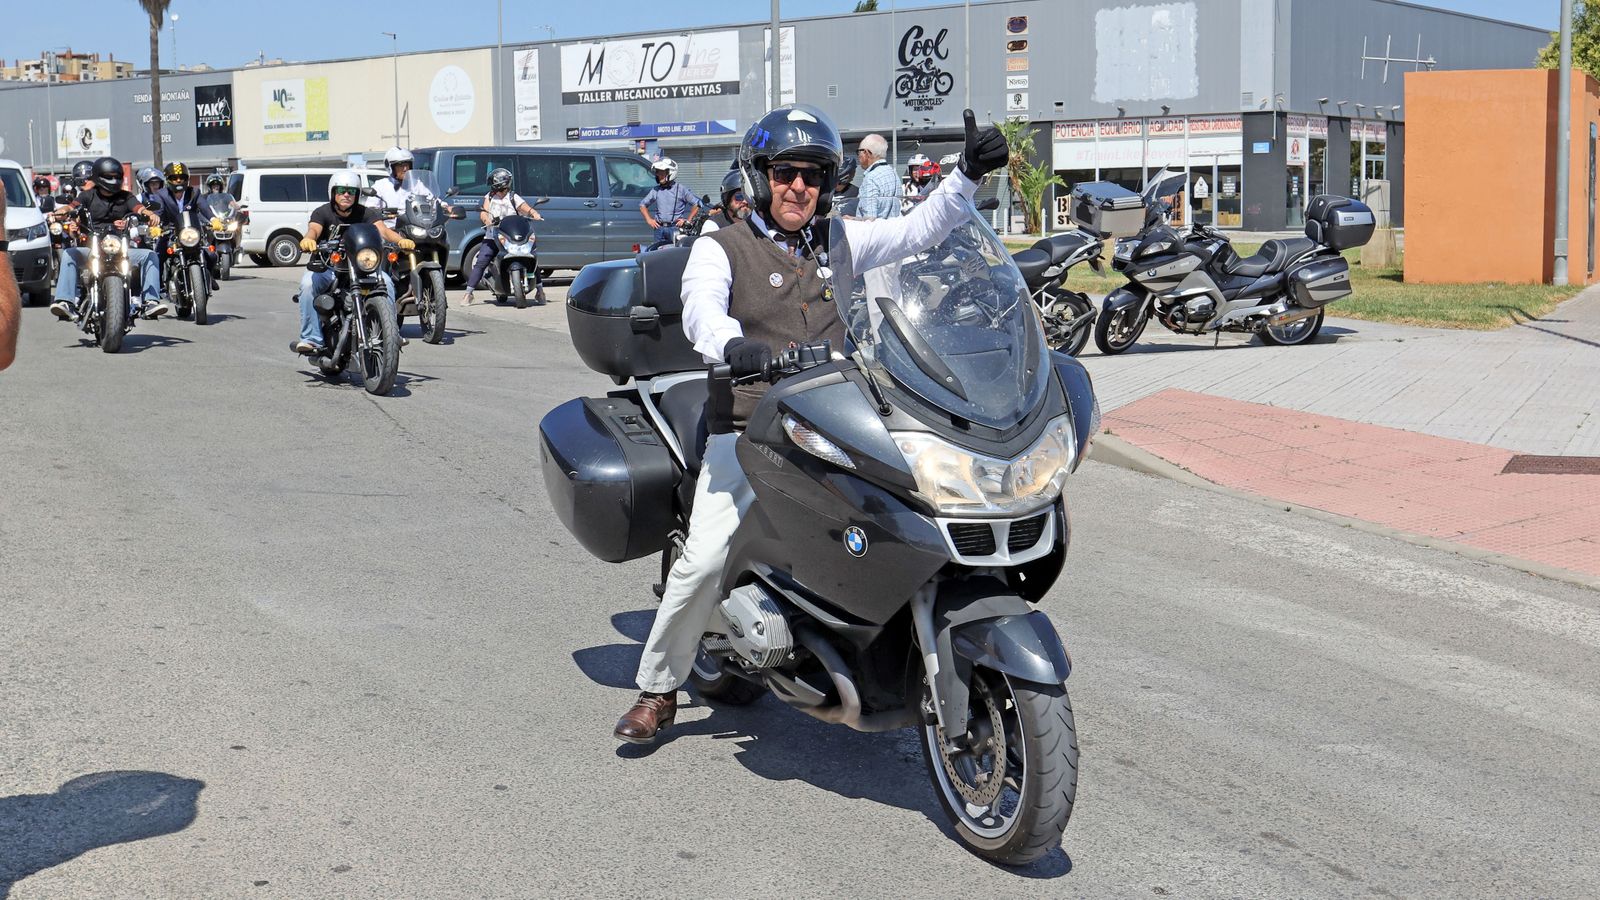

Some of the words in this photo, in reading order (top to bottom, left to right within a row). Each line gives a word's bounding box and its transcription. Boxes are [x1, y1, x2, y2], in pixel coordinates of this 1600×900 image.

[897, 24, 949, 67] Cool
[133, 94, 152, 103] TIENDA
[161, 90, 190, 101] MONTAÑA
[578, 92, 612, 103] TALLER
[615, 88, 669, 101] MECANICO
[672, 86, 679, 97] Y
[681, 83, 722, 96] VENTAS
[904, 97, 943, 107] MOTORCYCLES
[196, 102, 219, 117] YAK
[143, 113, 180, 123] ROCDROMO
[581, 129, 600, 137] MOTO
[601, 128, 619, 136] ZONE
[682, 124, 696, 132] JEREZ
[1055, 123, 1095, 138] POTENCIA
[1100, 121, 1141, 135] EQUILIBRIO
[1150, 118, 1184, 133] AGILIDAD
